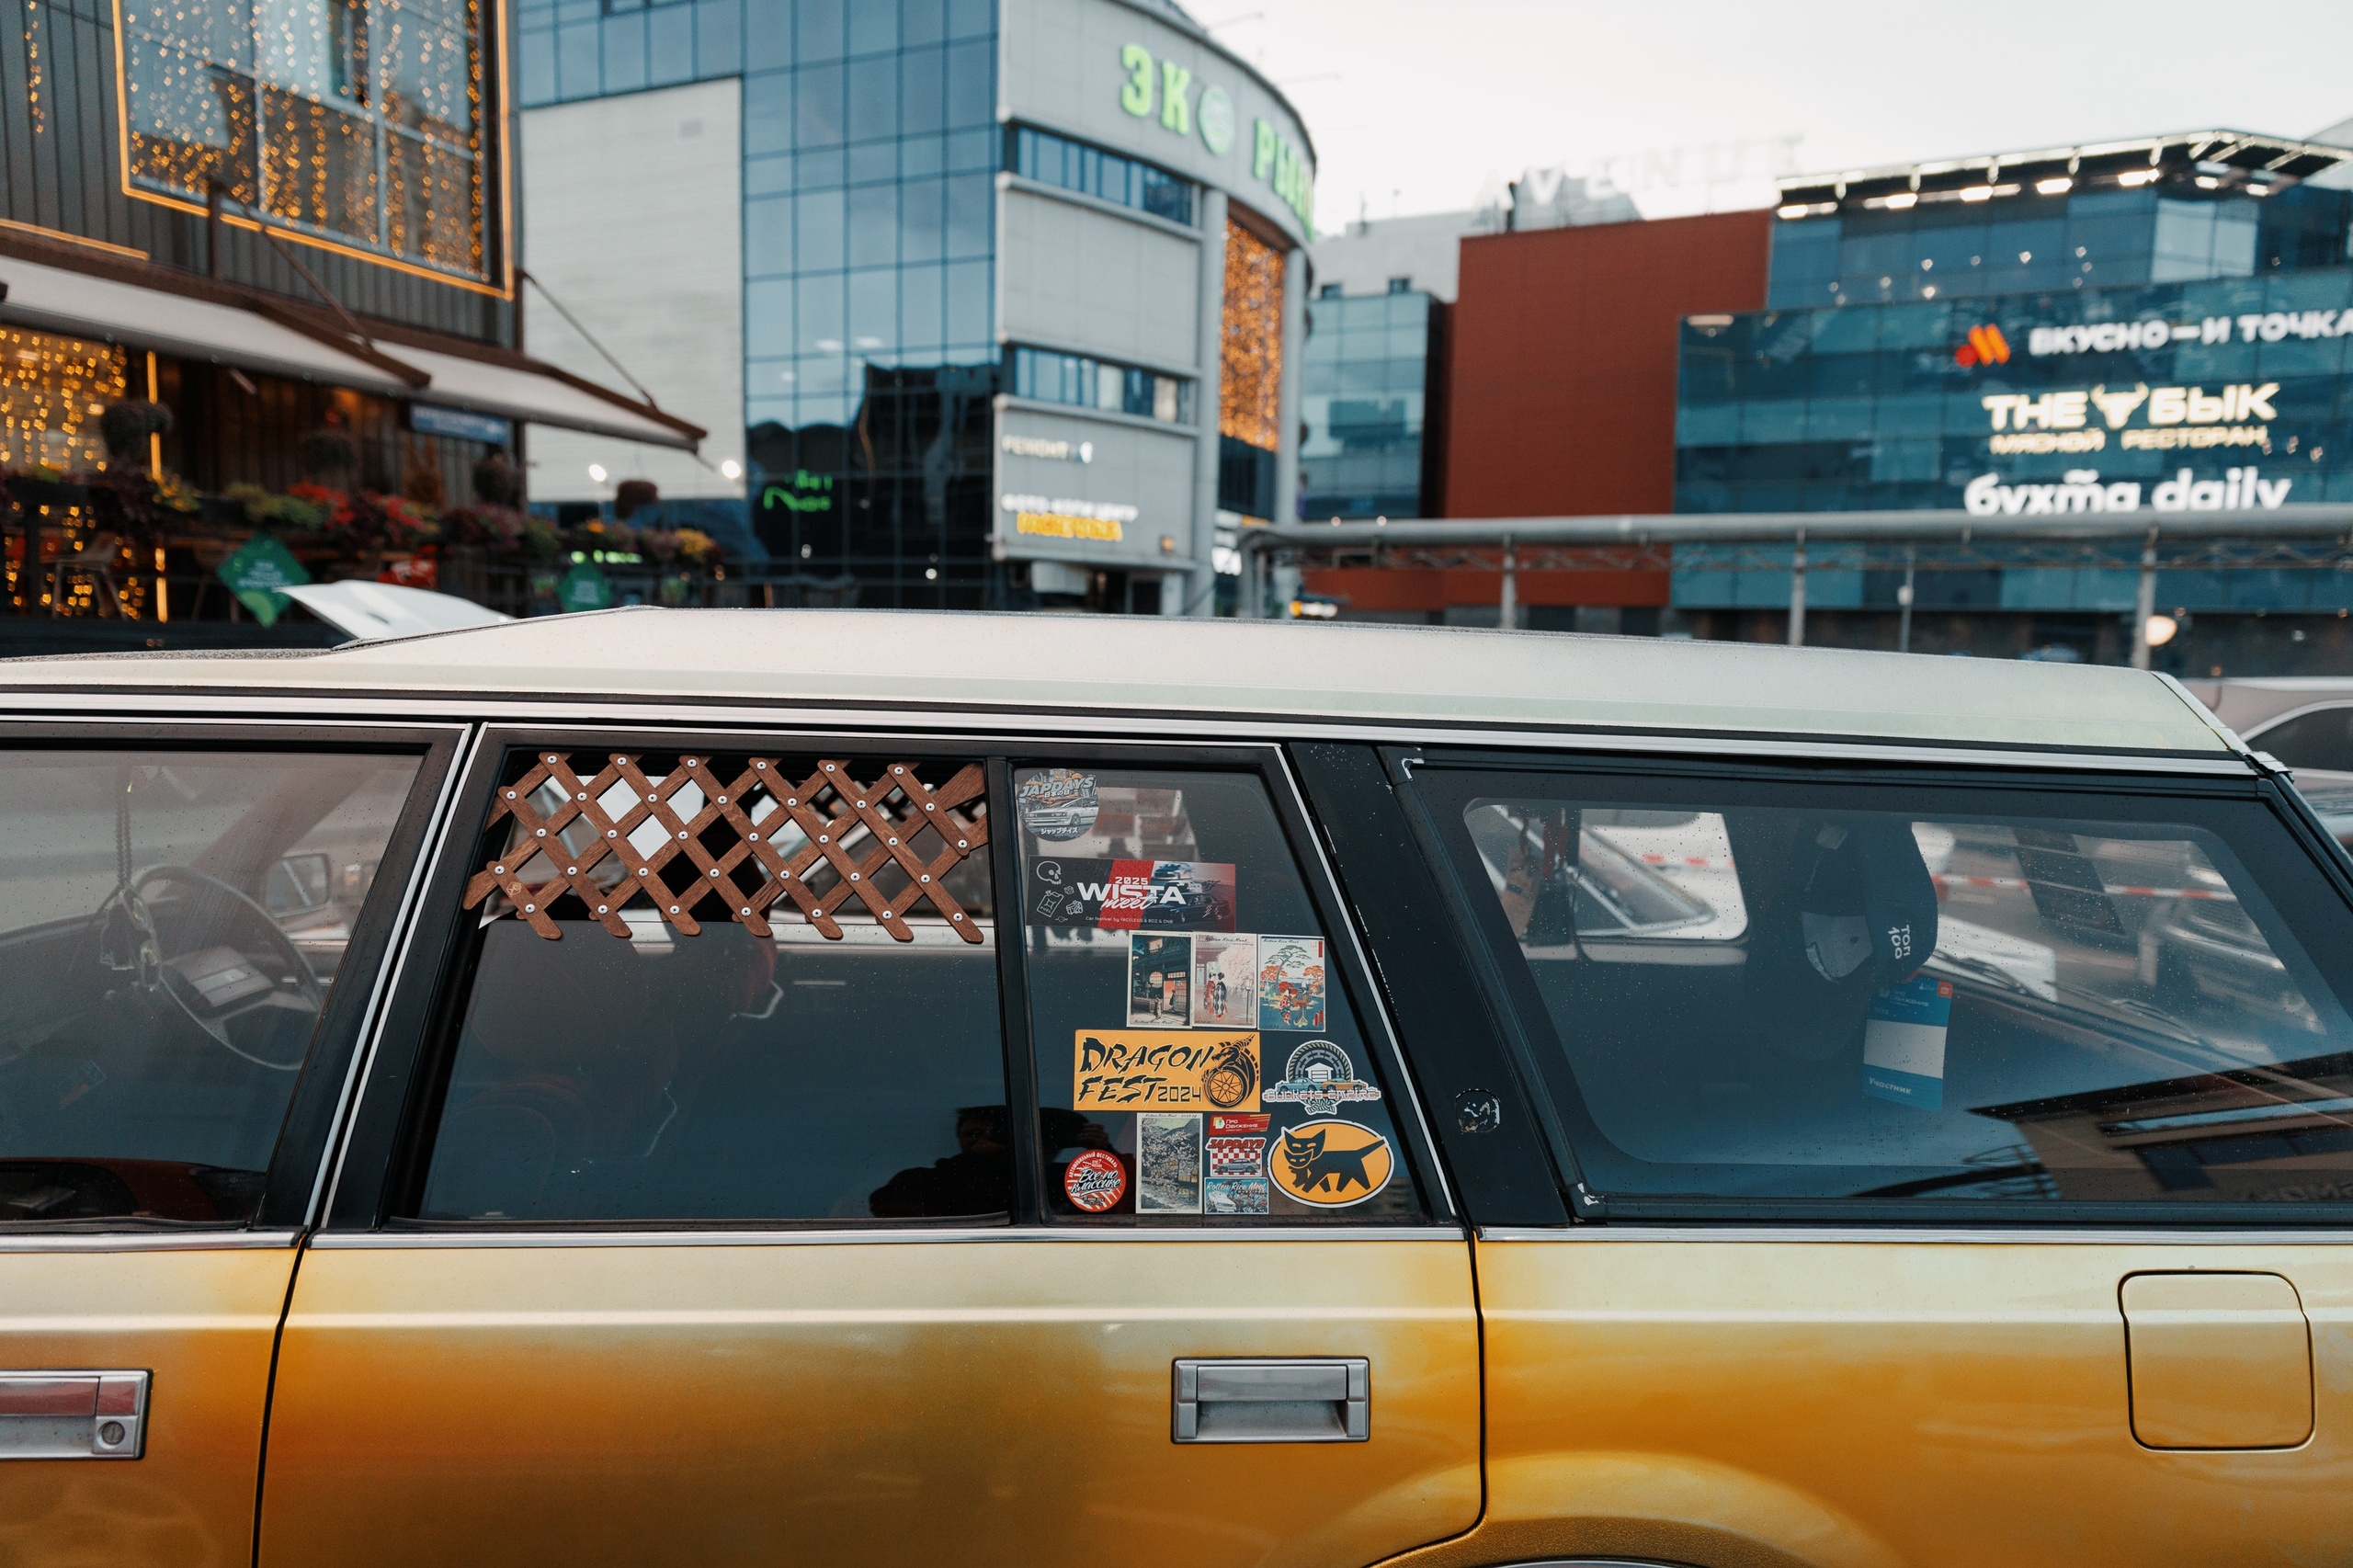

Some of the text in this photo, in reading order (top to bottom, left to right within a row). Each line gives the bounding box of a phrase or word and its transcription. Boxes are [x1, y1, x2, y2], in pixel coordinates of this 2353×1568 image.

[1982, 381, 2281, 430] THE БЫК
[1989, 425, 2268, 455] МЯСНОЙ РЕСТОРАН
[1018, 777, 1095, 798] JAPDAYS
[1115, 876, 1149, 885] 2025
[1076, 881, 1187, 905] WISTA
[1100, 895, 1158, 911] meet
[1888, 926, 1903, 960] 100
[1901, 925, 1911, 957] ТОП
[1079, 1036, 1215, 1074] DRAGON
[1077, 1074, 1202, 1104] FEST 2024
[1869, 1075, 1912, 1096] Участник
[1208, 1138, 1266, 1149] JAPDAYS
[1096, 1152, 1119, 1168] ФЕСТИВАЛЬ
[1078, 1167, 1120, 1184] Все по
[1206, 1181, 1230, 1190] Rotten
